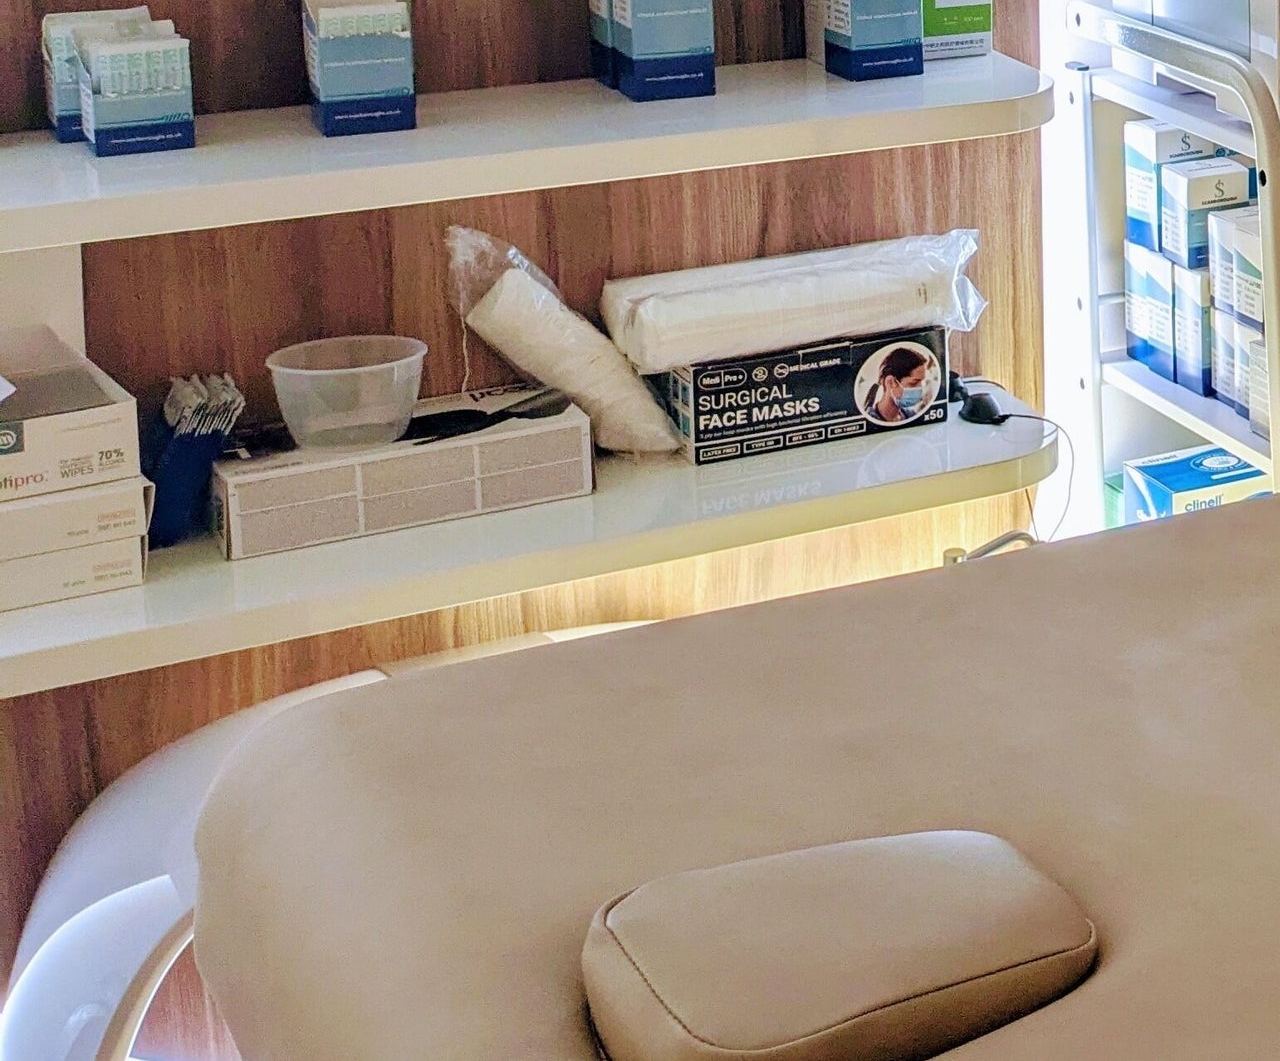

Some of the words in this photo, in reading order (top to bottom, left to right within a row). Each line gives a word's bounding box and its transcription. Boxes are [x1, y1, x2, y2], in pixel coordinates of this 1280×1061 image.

[789, 361, 818, 372] MEDICAL
[820, 357, 842, 368] GRADE
[702, 375, 720, 386] Medi
[698, 384, 793, 412] SURGICAL
[699, 406, 749, 432] FACE
[752, 396, 820, 423] MASKS
[923, 407, 944, 422] x50
[735, 425, 754, 434] masks
[703, 447, 721, 458] LATEX
[722, 445, 737, 455] FREE
[751, 440, 766, 450] TYPE
[98, 447, 124, 462] 70%
[1142, 453, 1178, 466] clinell
[60, 465, 94, 479] WIPES
[1185, 494, 1223, 513] clinell
